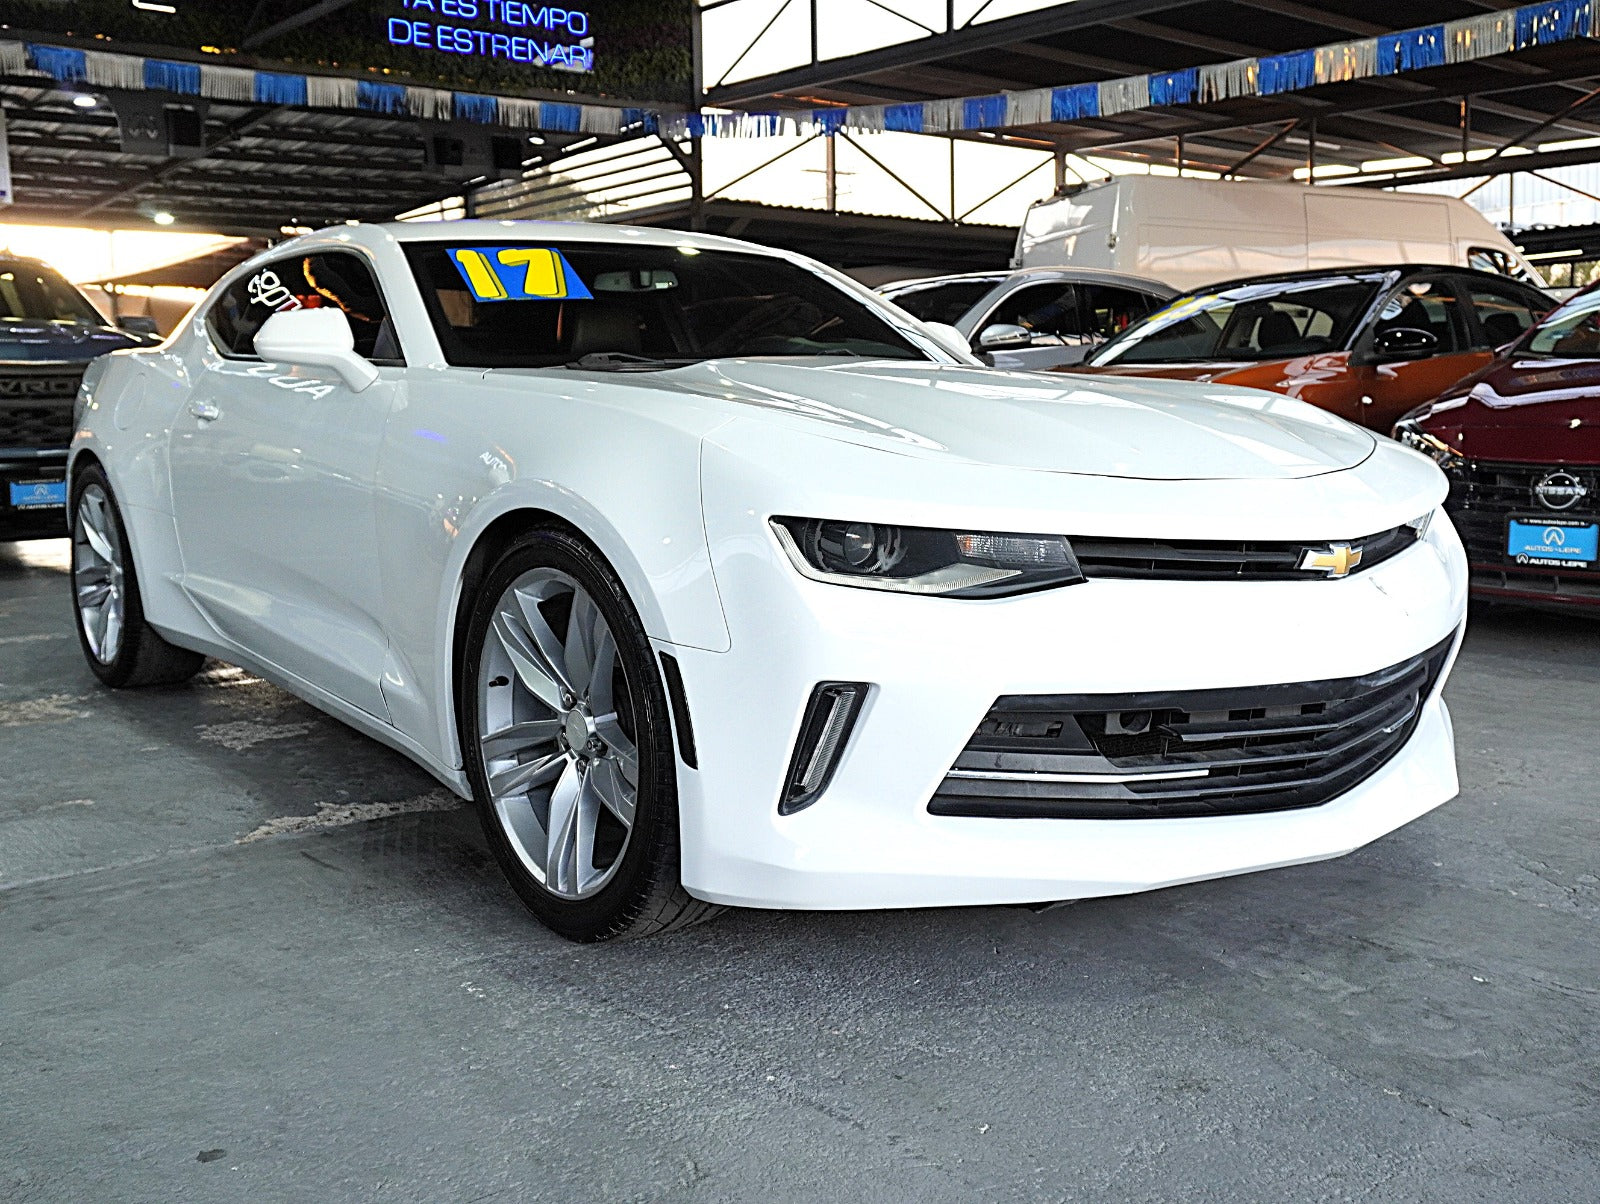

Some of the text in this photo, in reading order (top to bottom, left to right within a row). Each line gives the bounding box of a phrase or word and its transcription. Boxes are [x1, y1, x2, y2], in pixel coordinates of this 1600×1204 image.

[388, 17, 432, 48] DE
[482, 0, 587, 35] TIEMPO
[455, 248, 567, 299] 17
[1535, 485, 1587, 496] NISSAN
